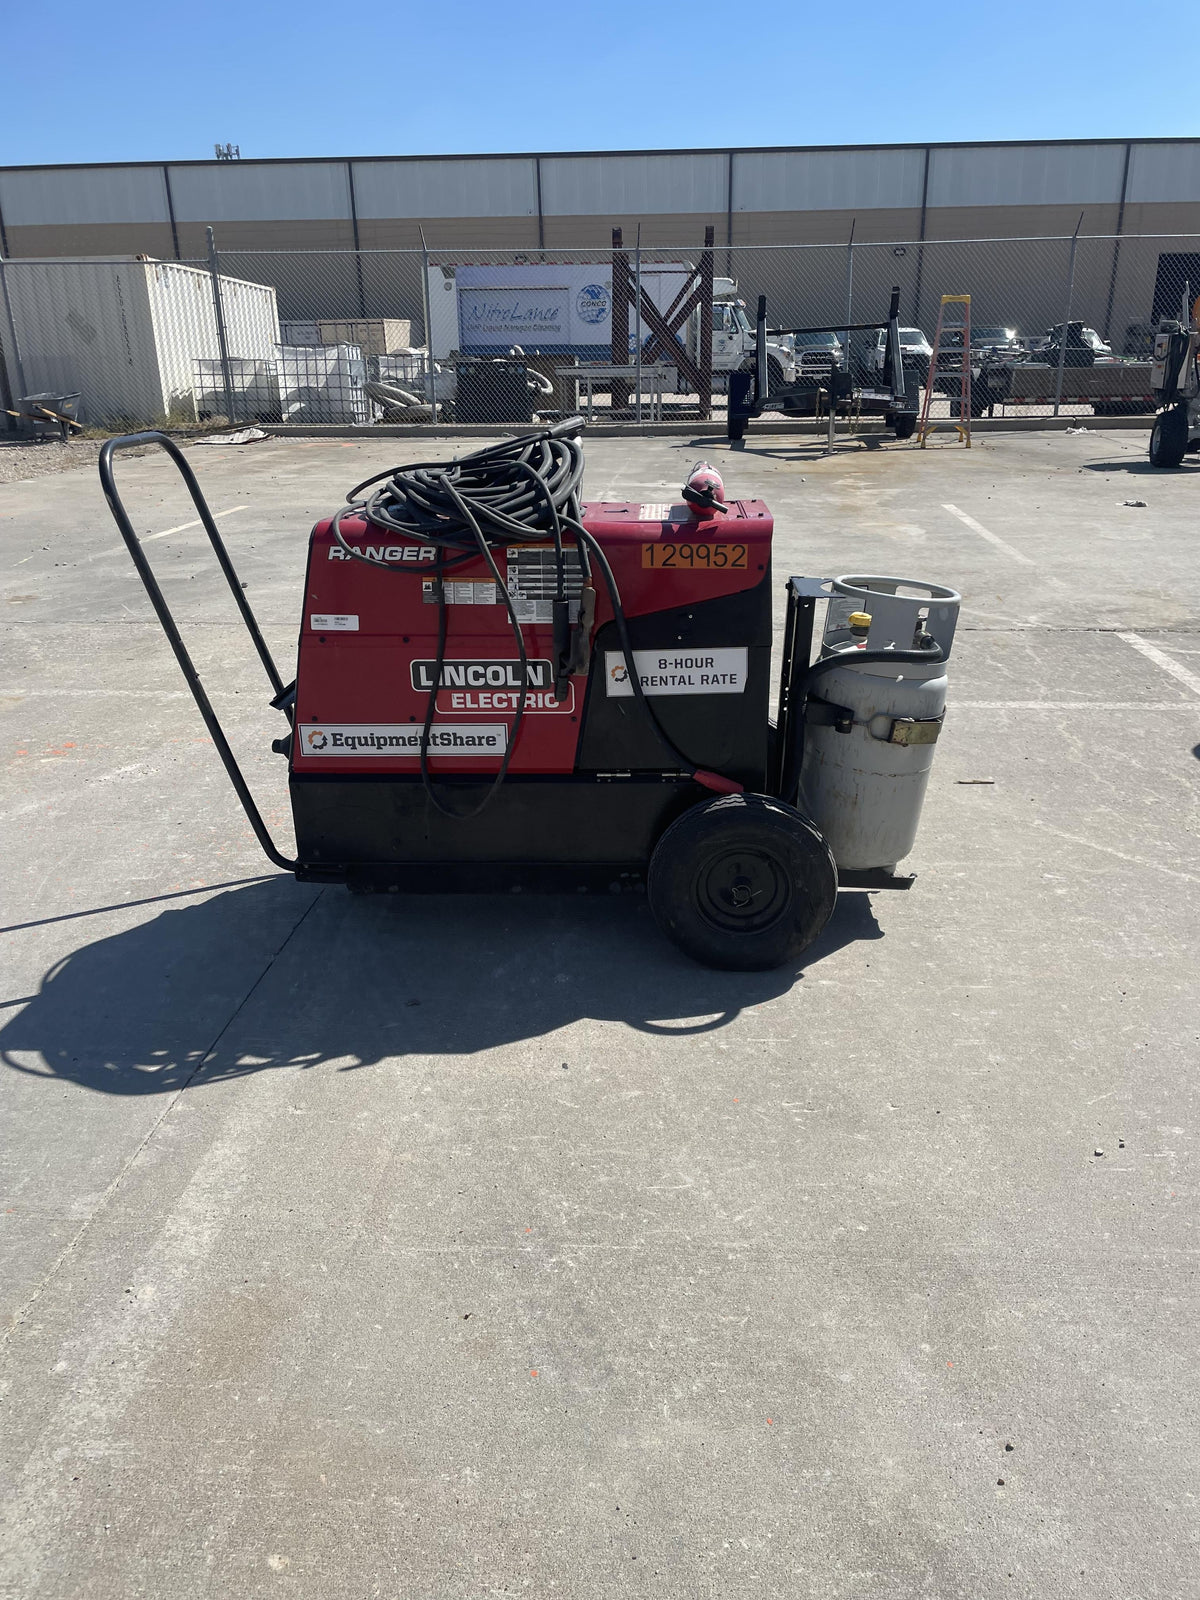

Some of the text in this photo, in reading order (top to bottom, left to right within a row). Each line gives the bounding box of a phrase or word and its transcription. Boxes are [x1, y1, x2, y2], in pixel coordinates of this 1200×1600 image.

[581, 300, 607, 308] CONCO
[469, 302, 560, 321] NitroLance
[328, 546, 436, 560] RANGER
[645, 543, 746, 568] 129952
[658, 657, 714, 670] 8-HOUR
[640, 673, 737, 687] RENTAL RATE
[451, 692, 560, 708] ELECTRIC
